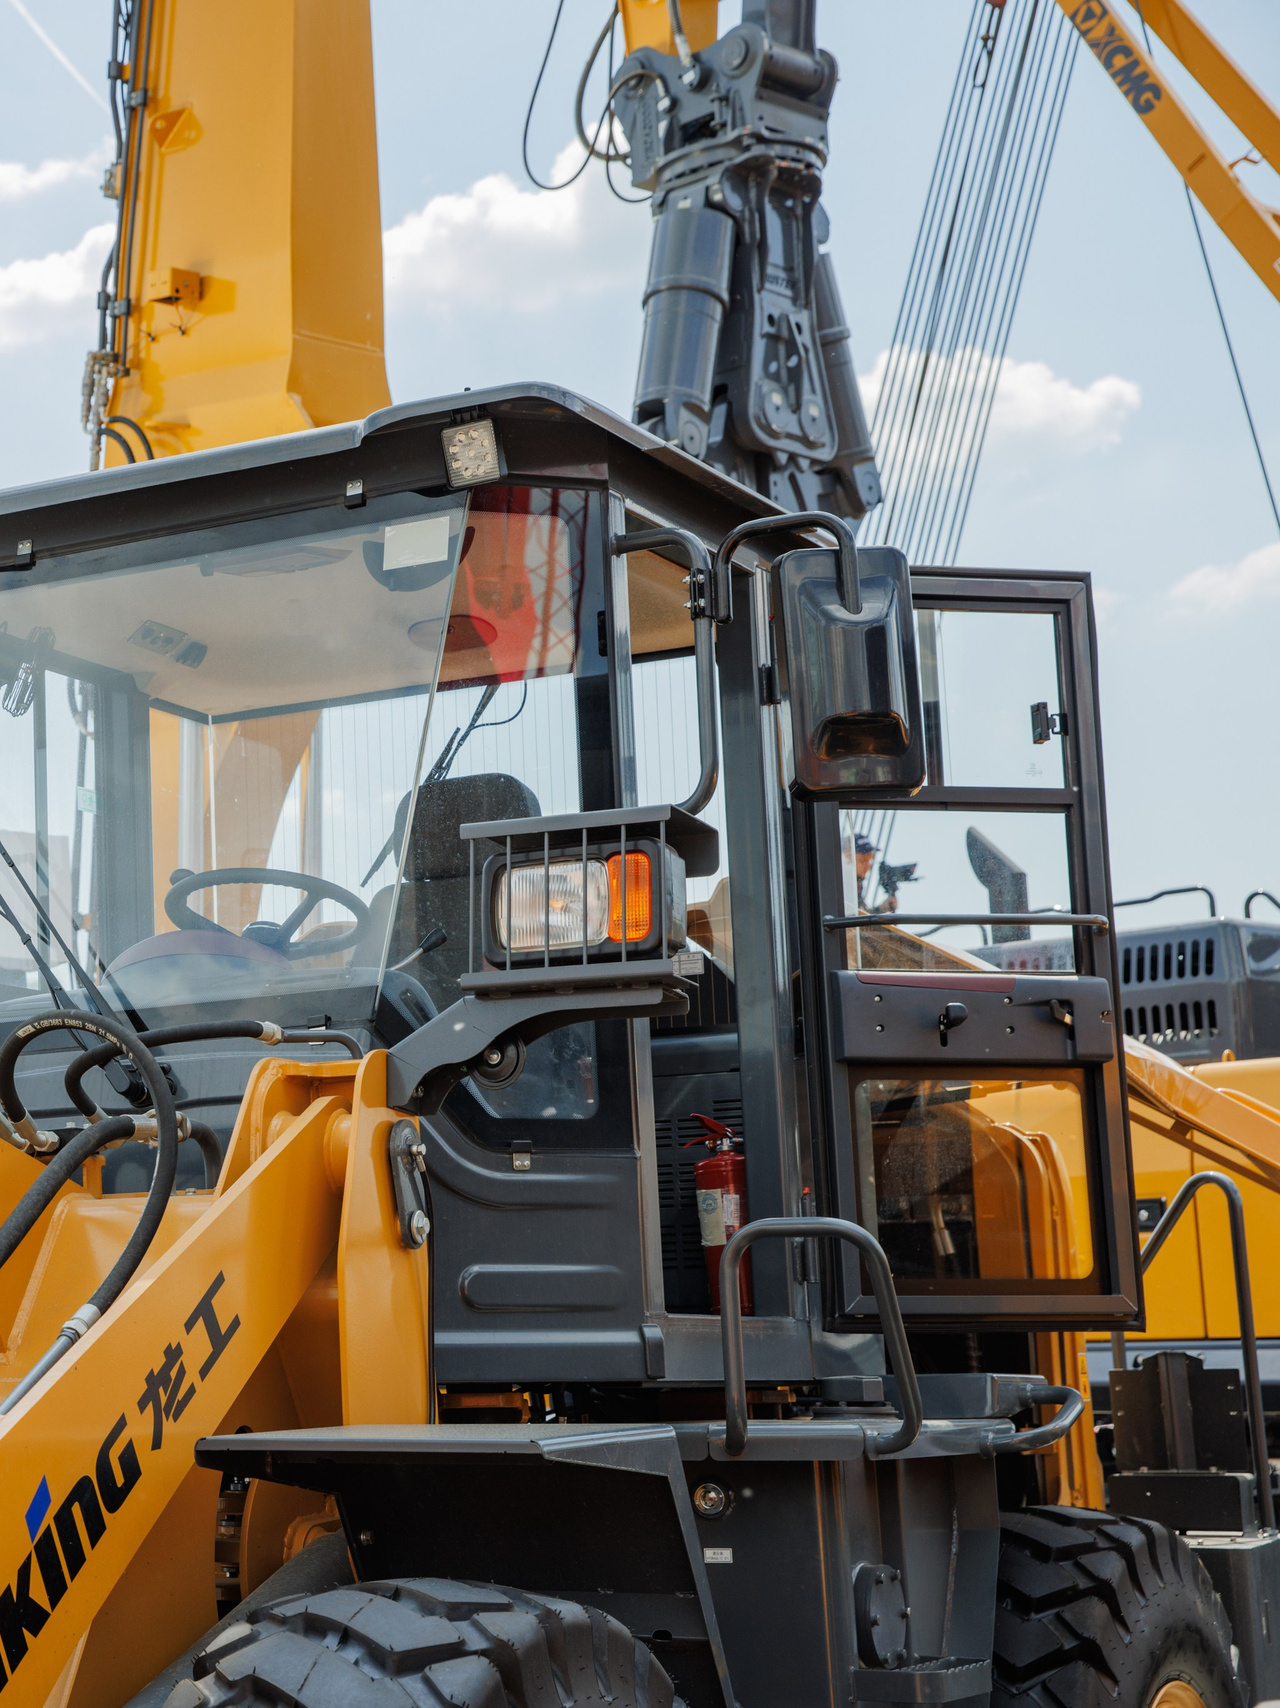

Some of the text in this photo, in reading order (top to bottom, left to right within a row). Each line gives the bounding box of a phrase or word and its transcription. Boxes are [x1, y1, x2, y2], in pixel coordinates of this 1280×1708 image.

[1085, 22, 1161, 115] XCMG
[64, 1018, 83, 1028] EN853
[85, 1022, 97, 1033] 2SN
